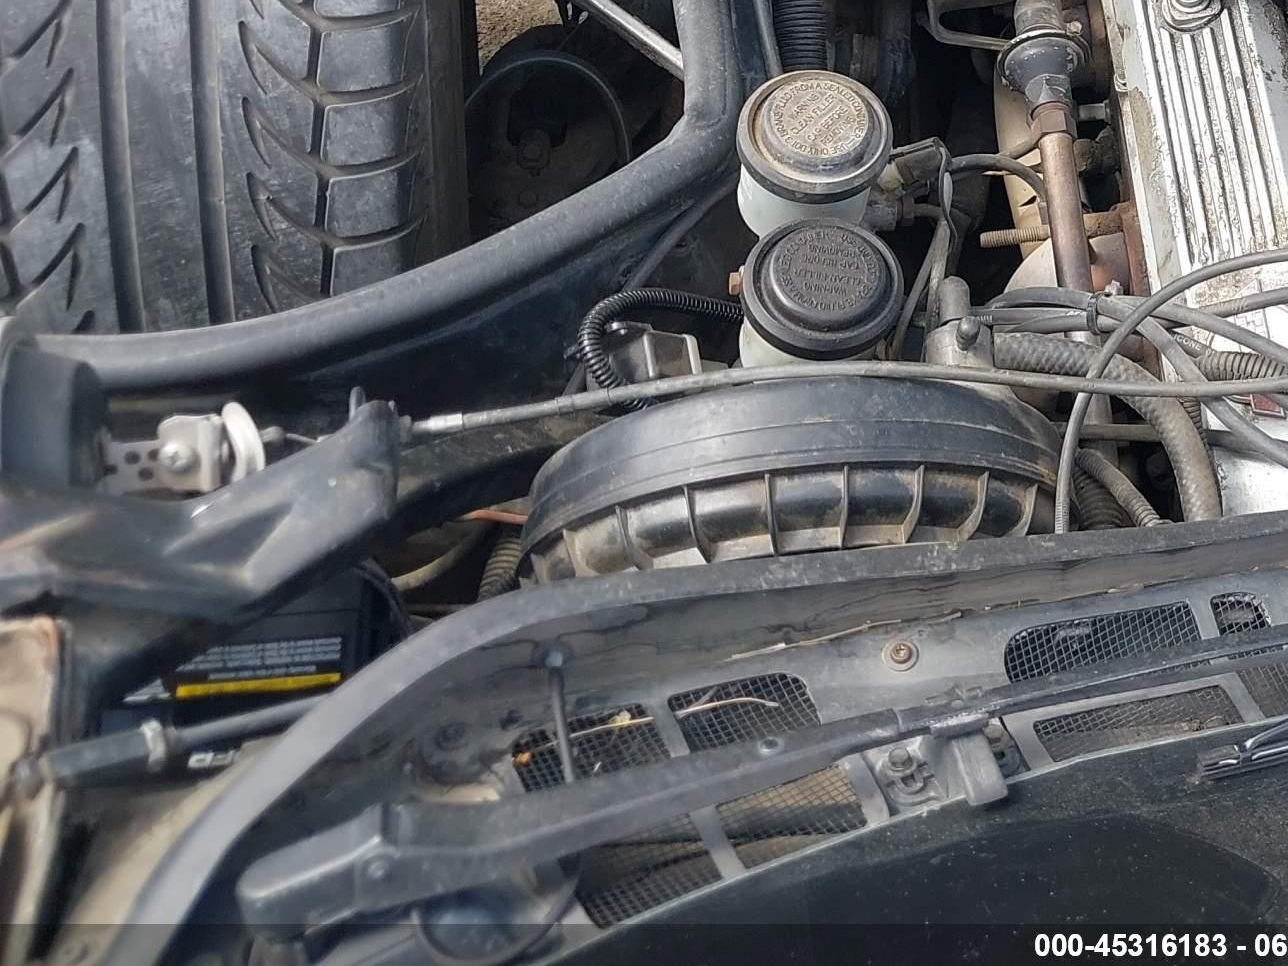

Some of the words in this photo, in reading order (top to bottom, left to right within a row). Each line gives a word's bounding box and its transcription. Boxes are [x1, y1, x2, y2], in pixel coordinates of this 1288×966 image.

[791, 83, 815, 97] FROM
[790, 115, 814, 135] CLEAN
[812, 92, 838, 116] FILLER
[822, 105, 849, 129] BEFORE
